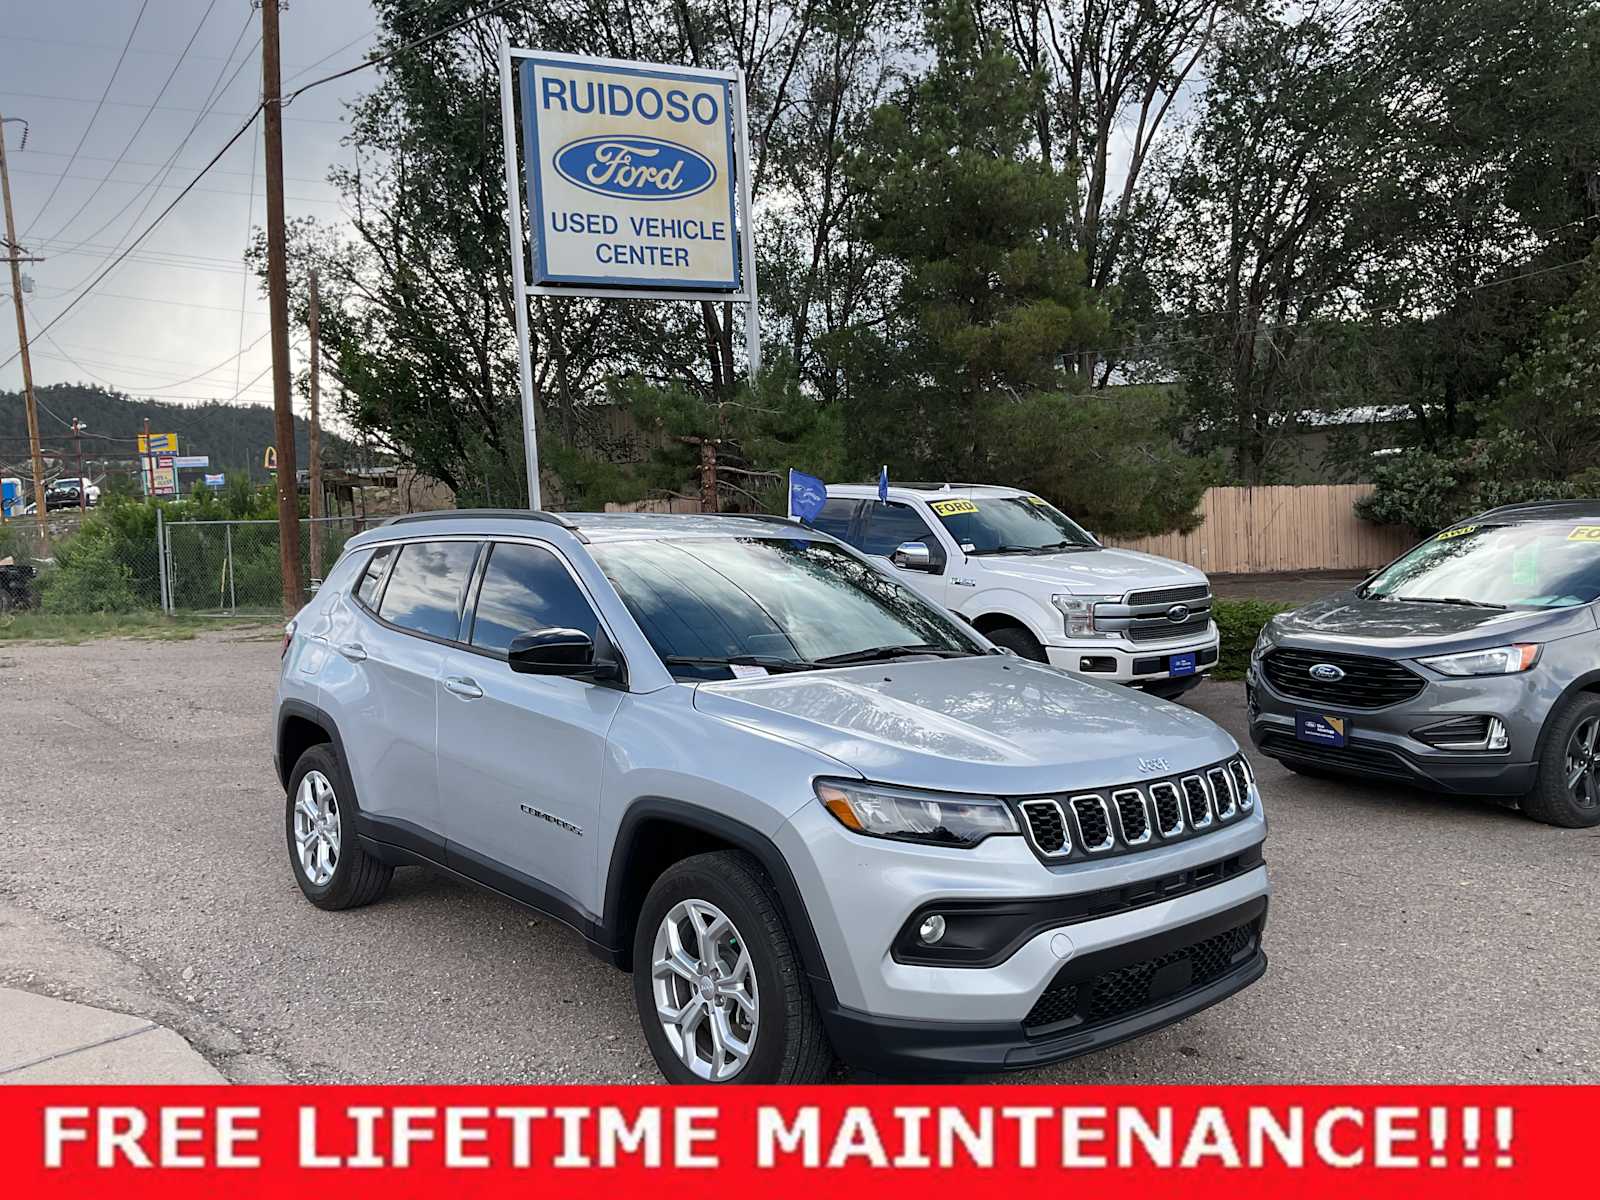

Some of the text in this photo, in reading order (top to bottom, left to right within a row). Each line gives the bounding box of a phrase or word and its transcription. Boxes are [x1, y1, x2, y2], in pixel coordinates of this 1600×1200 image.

[542, 77, 719, 126] RUIDOSO
[586, 143, 684, 192] Ford
[551, 212, 726, 241] USED VEHICLE
[596, 243, 689, 267] CENTER
[935, 501, 975, 513] FORD
[1137, 757, 1169, 773] Jeep
[520, 803, 583, 837] COMPASS
